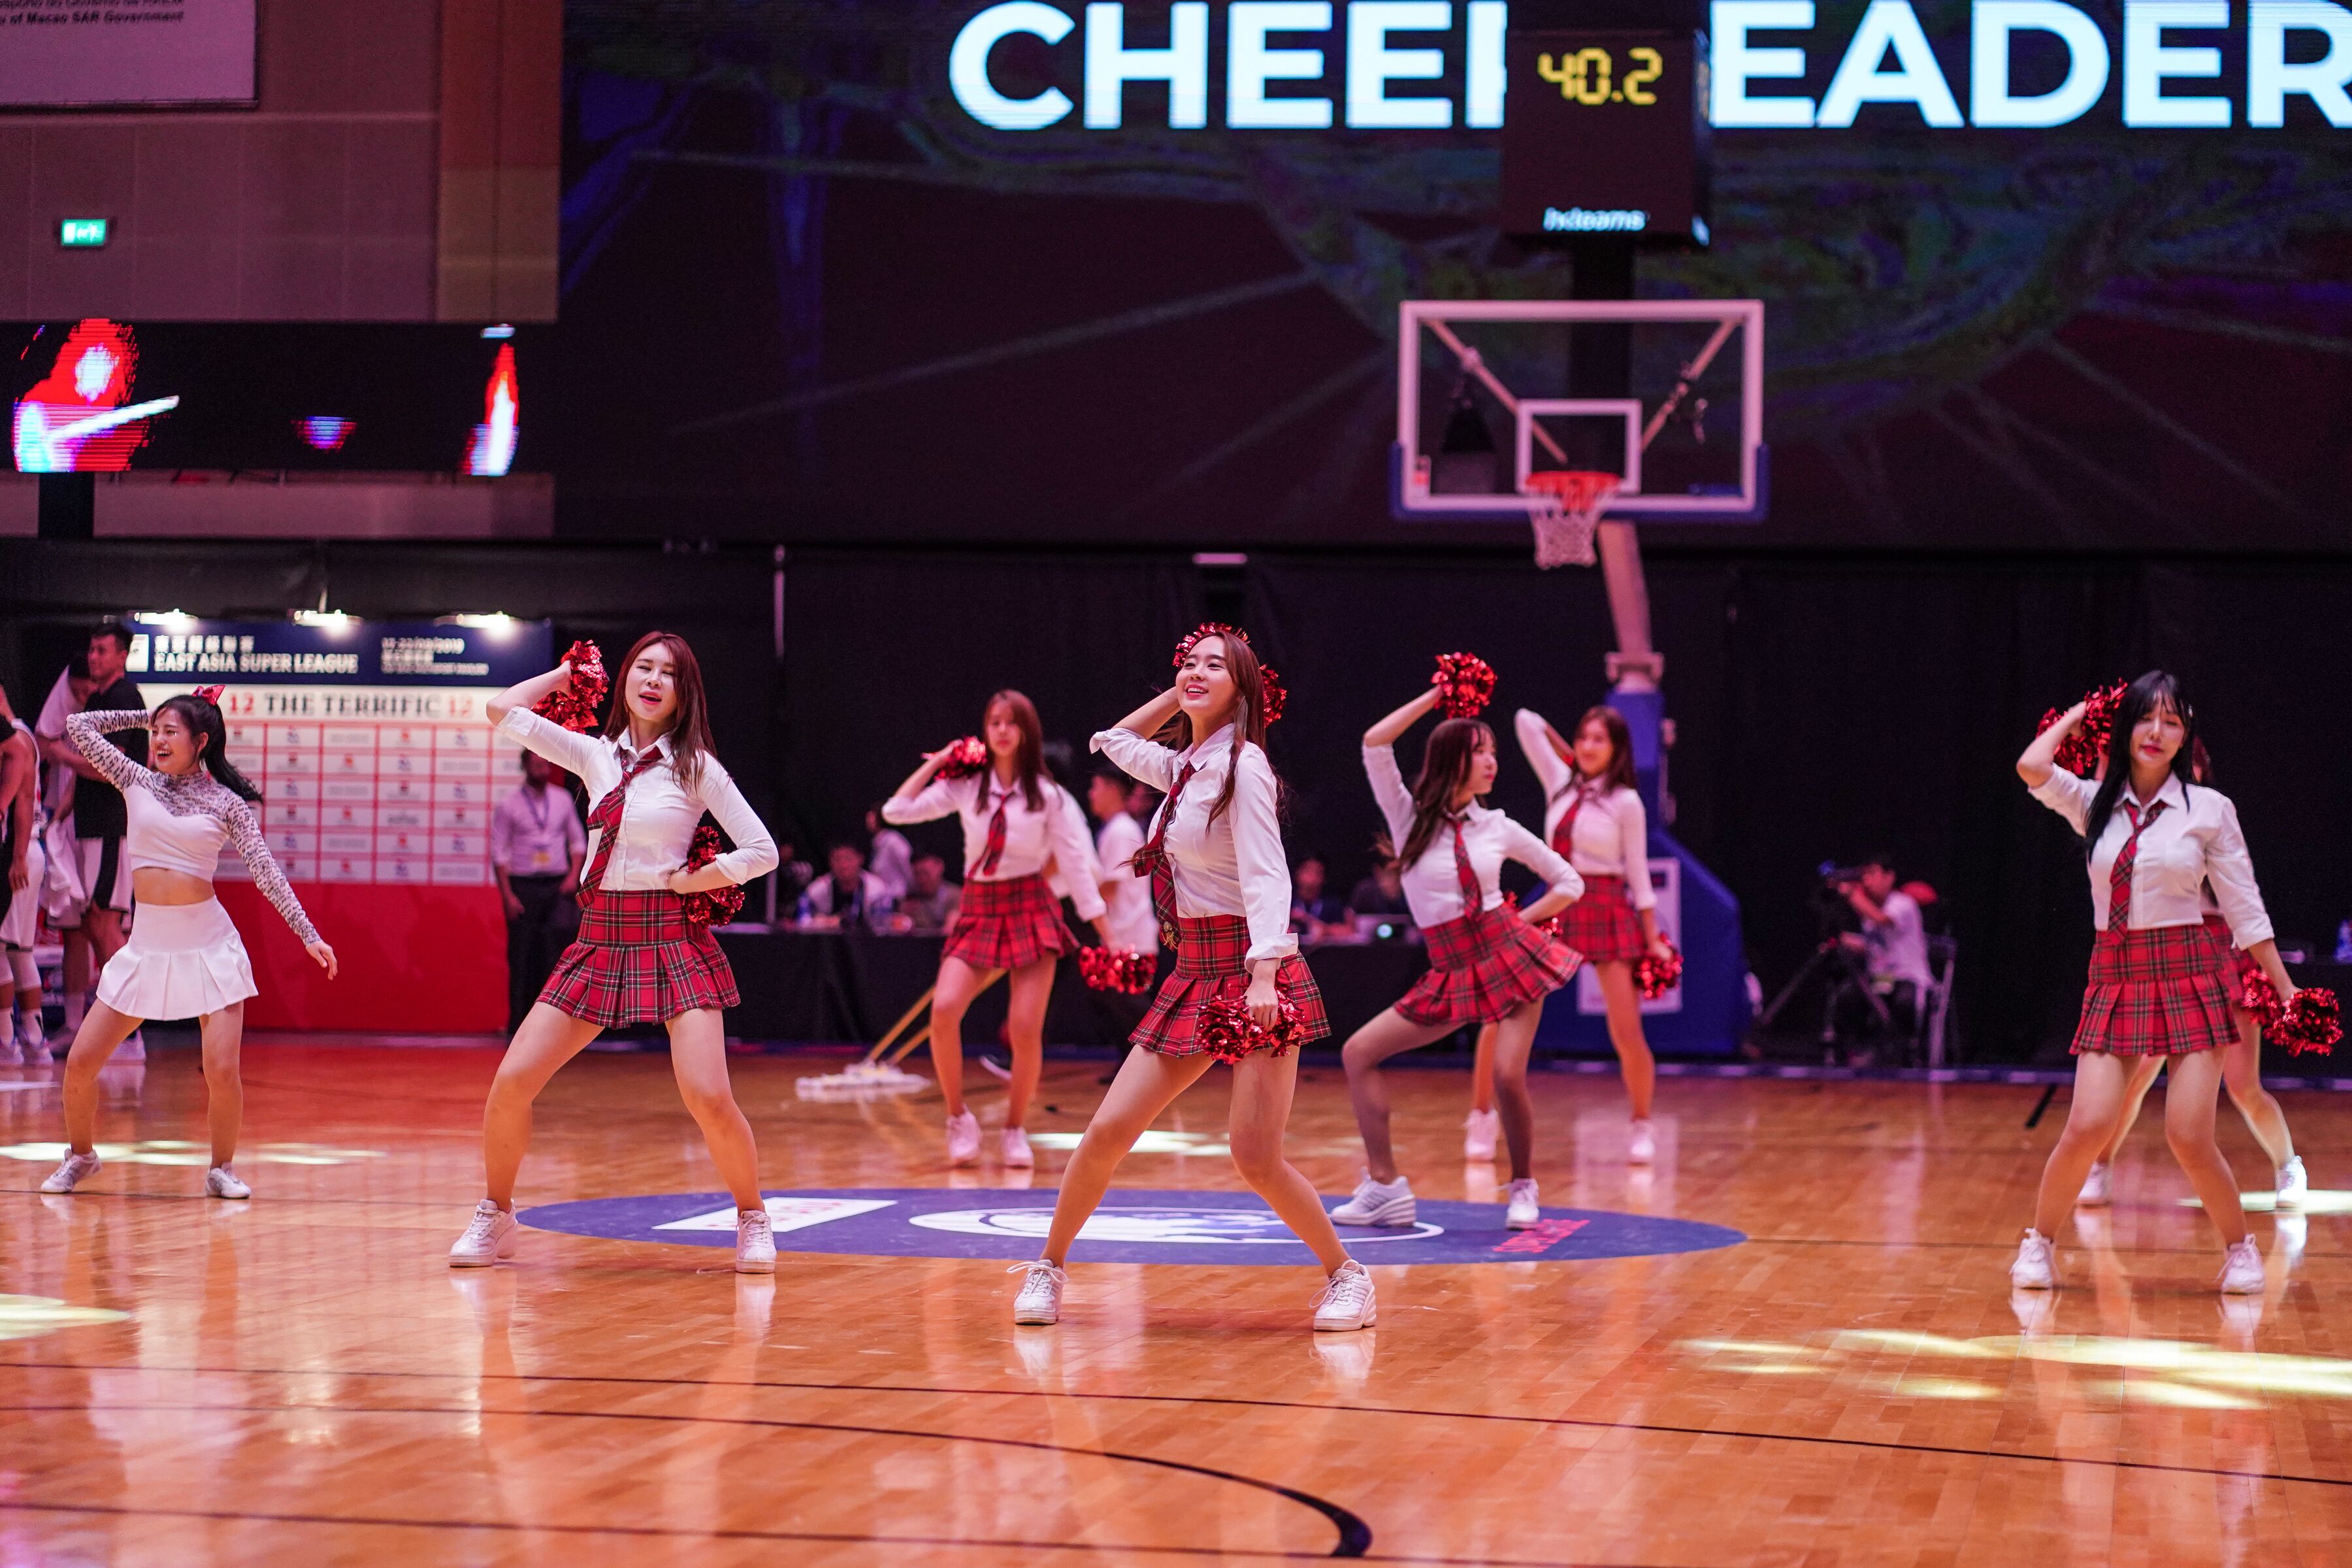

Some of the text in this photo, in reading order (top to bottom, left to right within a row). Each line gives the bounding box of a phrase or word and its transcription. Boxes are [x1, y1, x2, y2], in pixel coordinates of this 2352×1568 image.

[27, 12, 67, 24] Macao
[72, 10, 100, 24] SAR
[104, 10, 184, 24] Government
[1537, 47, 1663, 106] 40.2
[154, 653, 195, 672] EAST
[197, 653, 237, 672] ASIA
[239, 653, 293, 673] SUPER
[294, 654, 359, 674] LEAGUE
[230, 692, 474, 717] 12 THE TERRIFIC 12
